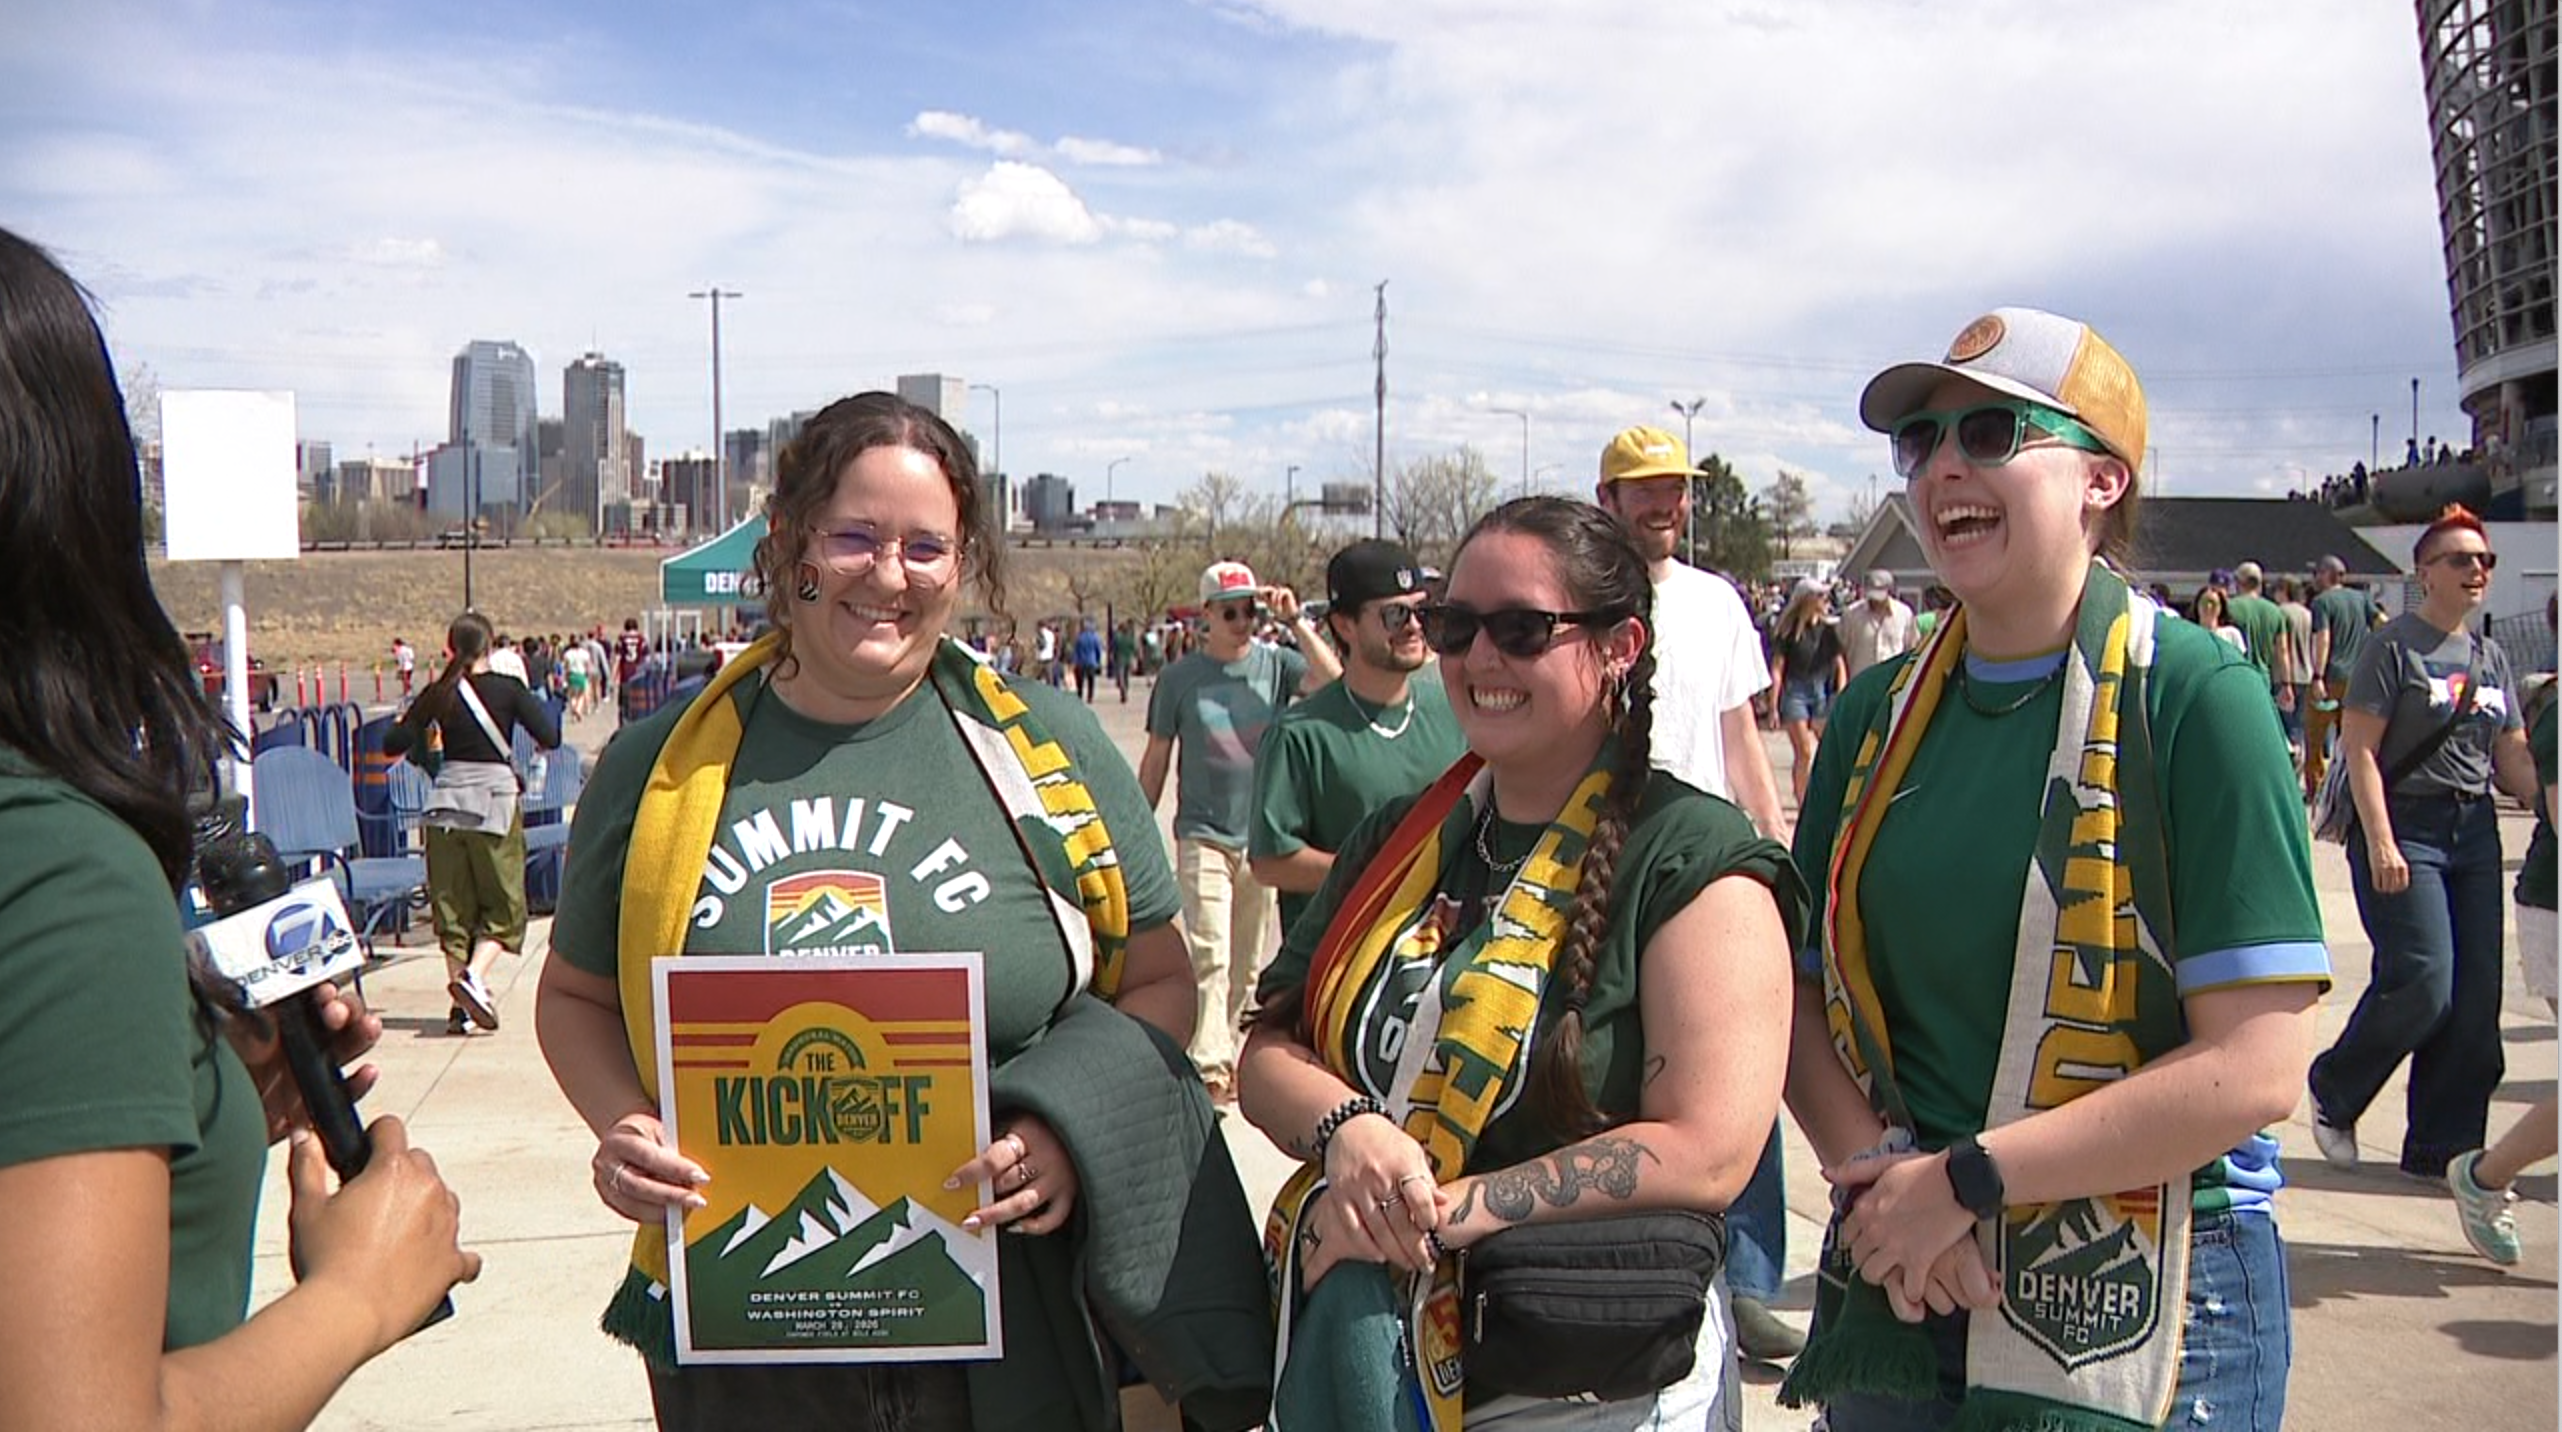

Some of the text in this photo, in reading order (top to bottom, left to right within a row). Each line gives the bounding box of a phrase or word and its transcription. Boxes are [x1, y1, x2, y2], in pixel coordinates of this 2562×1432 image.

[692, 796, 992, 929] SUMMIT FC
[236, 943, 323, 986] DENVER
[806, 1051, 836, 1073] THE
[750, 1289, 920, 1303] DENVER SUMMIT FC
[2018, 1269, 2141, 1319] DENVER
[747, 1307, 926, 1320] WASHINGTON SPIRIT
[2034, 1303, 2122, 1332] SUMMIT
[2062, 1324, 2089, 1345] FC
